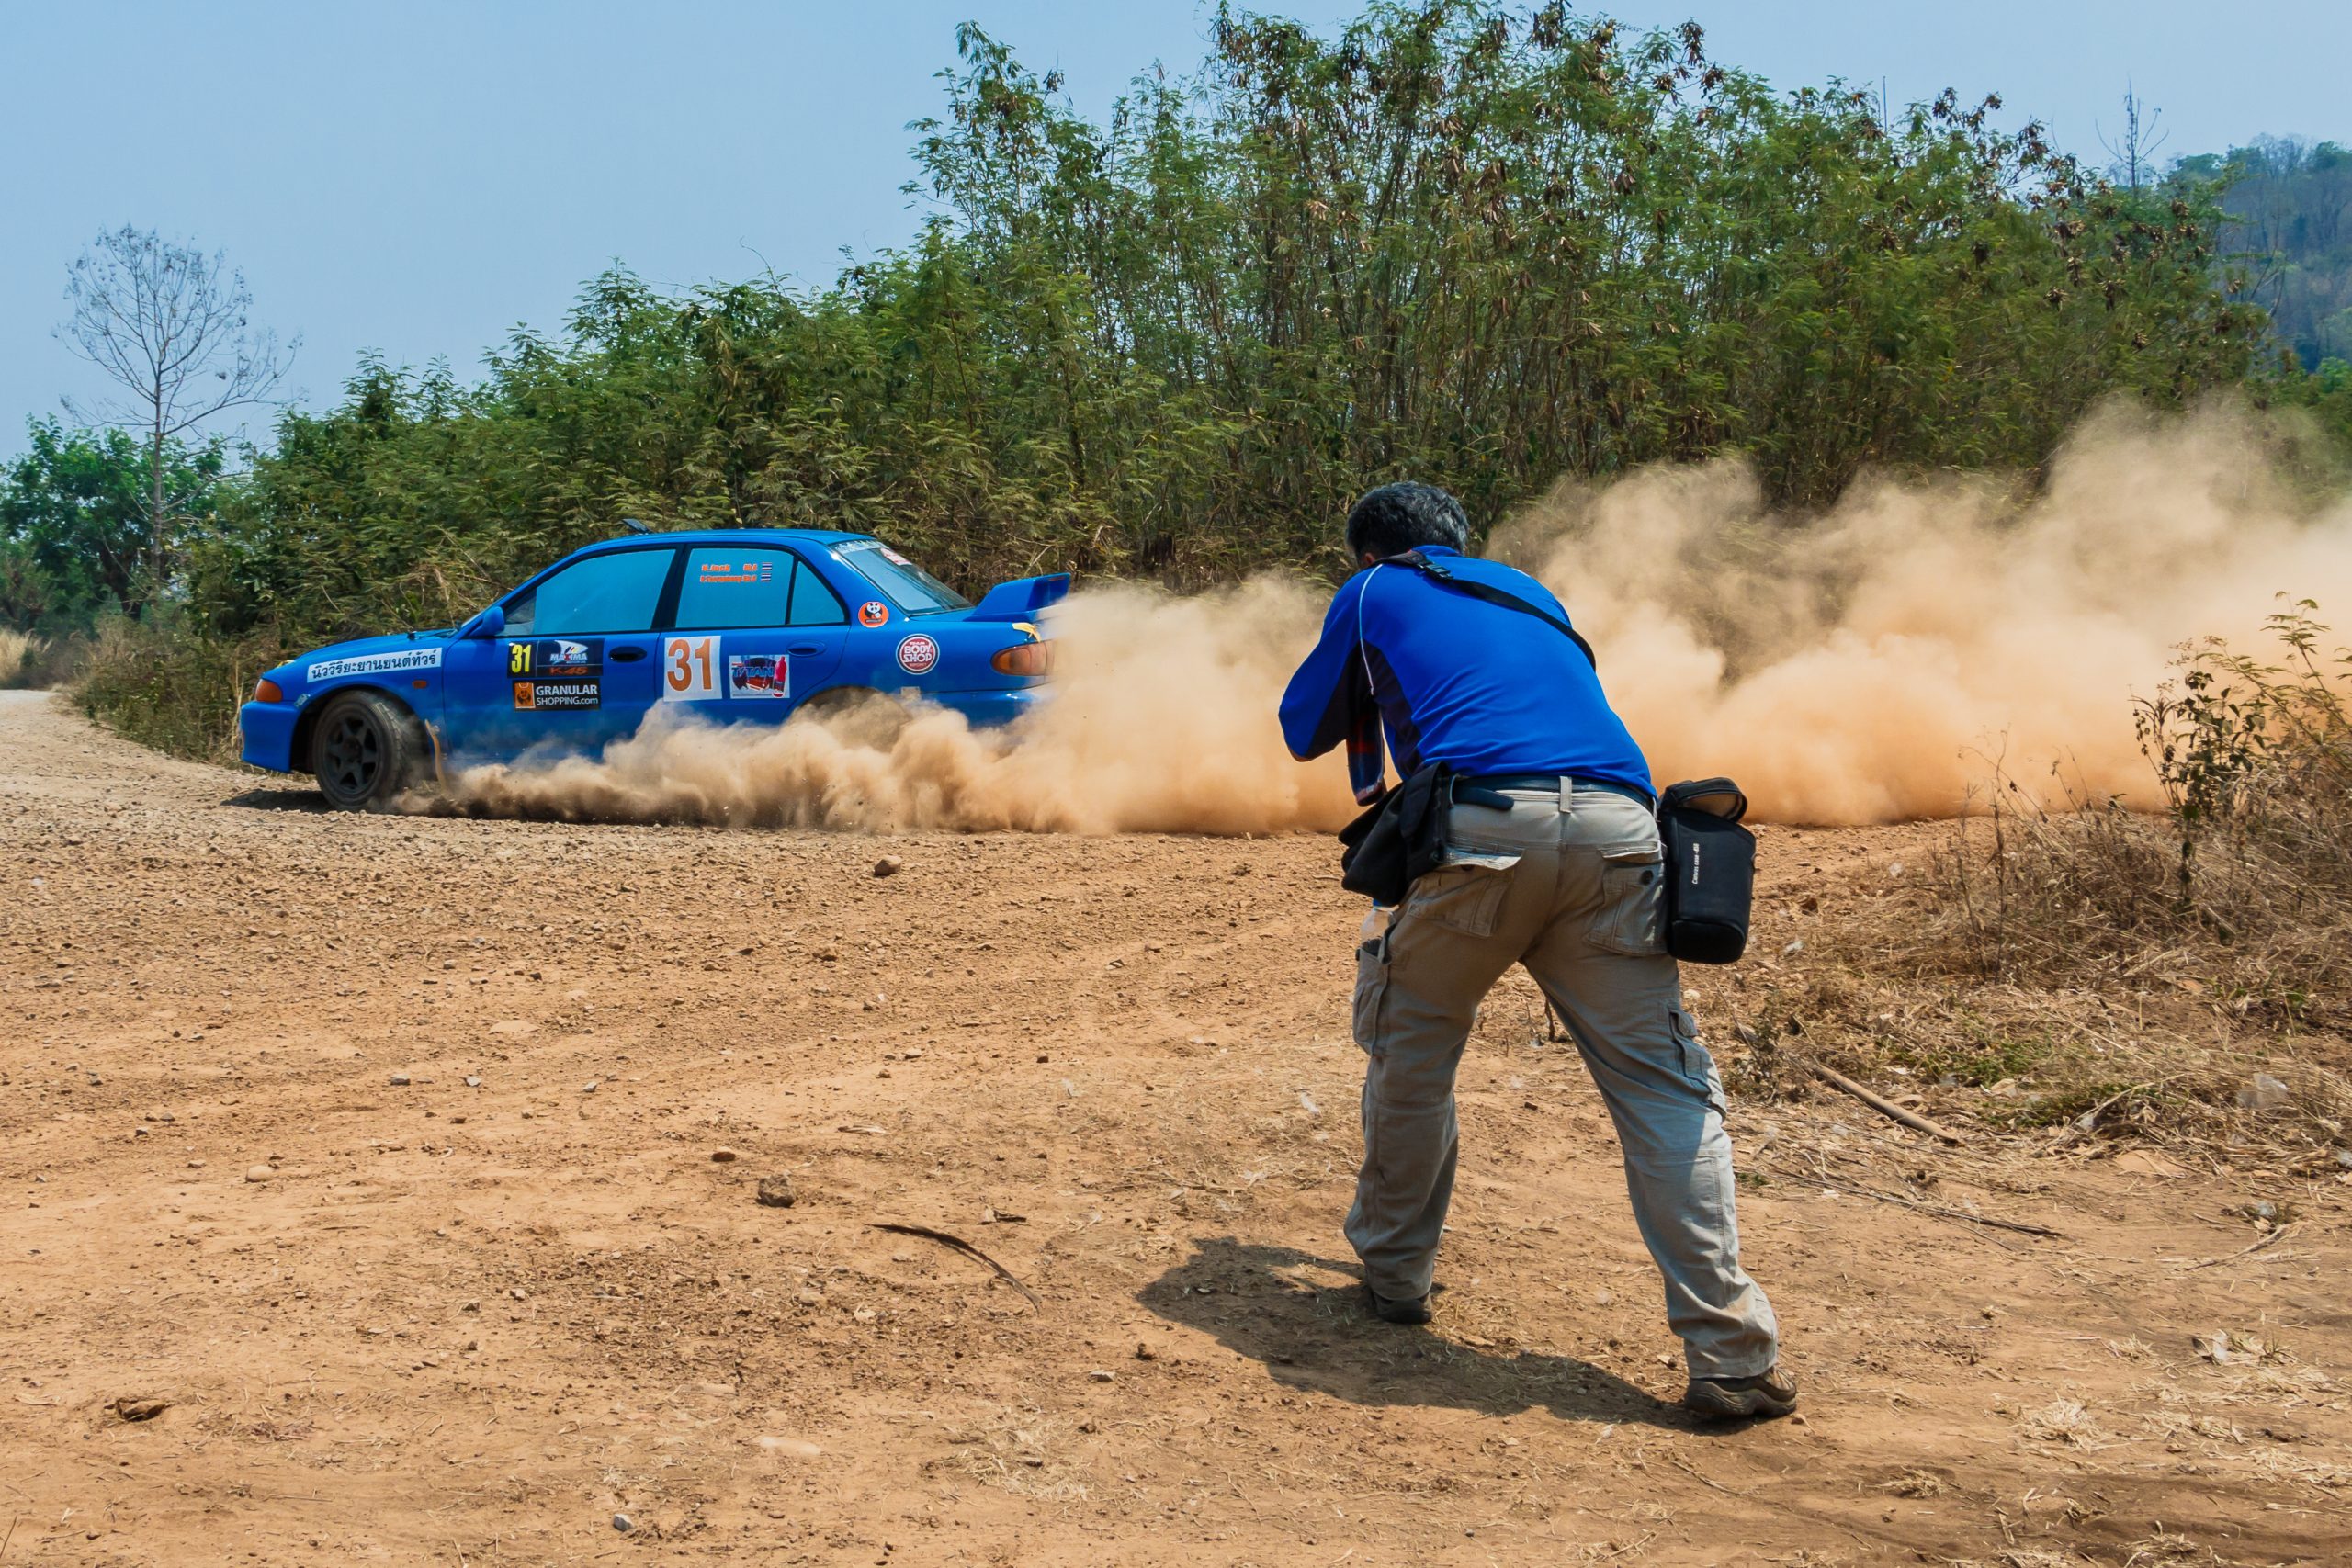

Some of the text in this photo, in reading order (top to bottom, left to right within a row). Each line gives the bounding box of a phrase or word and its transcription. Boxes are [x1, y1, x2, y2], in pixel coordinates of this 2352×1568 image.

[904, 643, 932, 653] BODY
[512, 645, 532, 672] 31
[550, 653, 588, 661] MAXIMA
[903, 653, 932, 662] SHOP
[667, 638, 712, 692] 31
[536, 684, 598, 695] GRANULAR
[537, 696, 598, 705] SHOPPING.com
